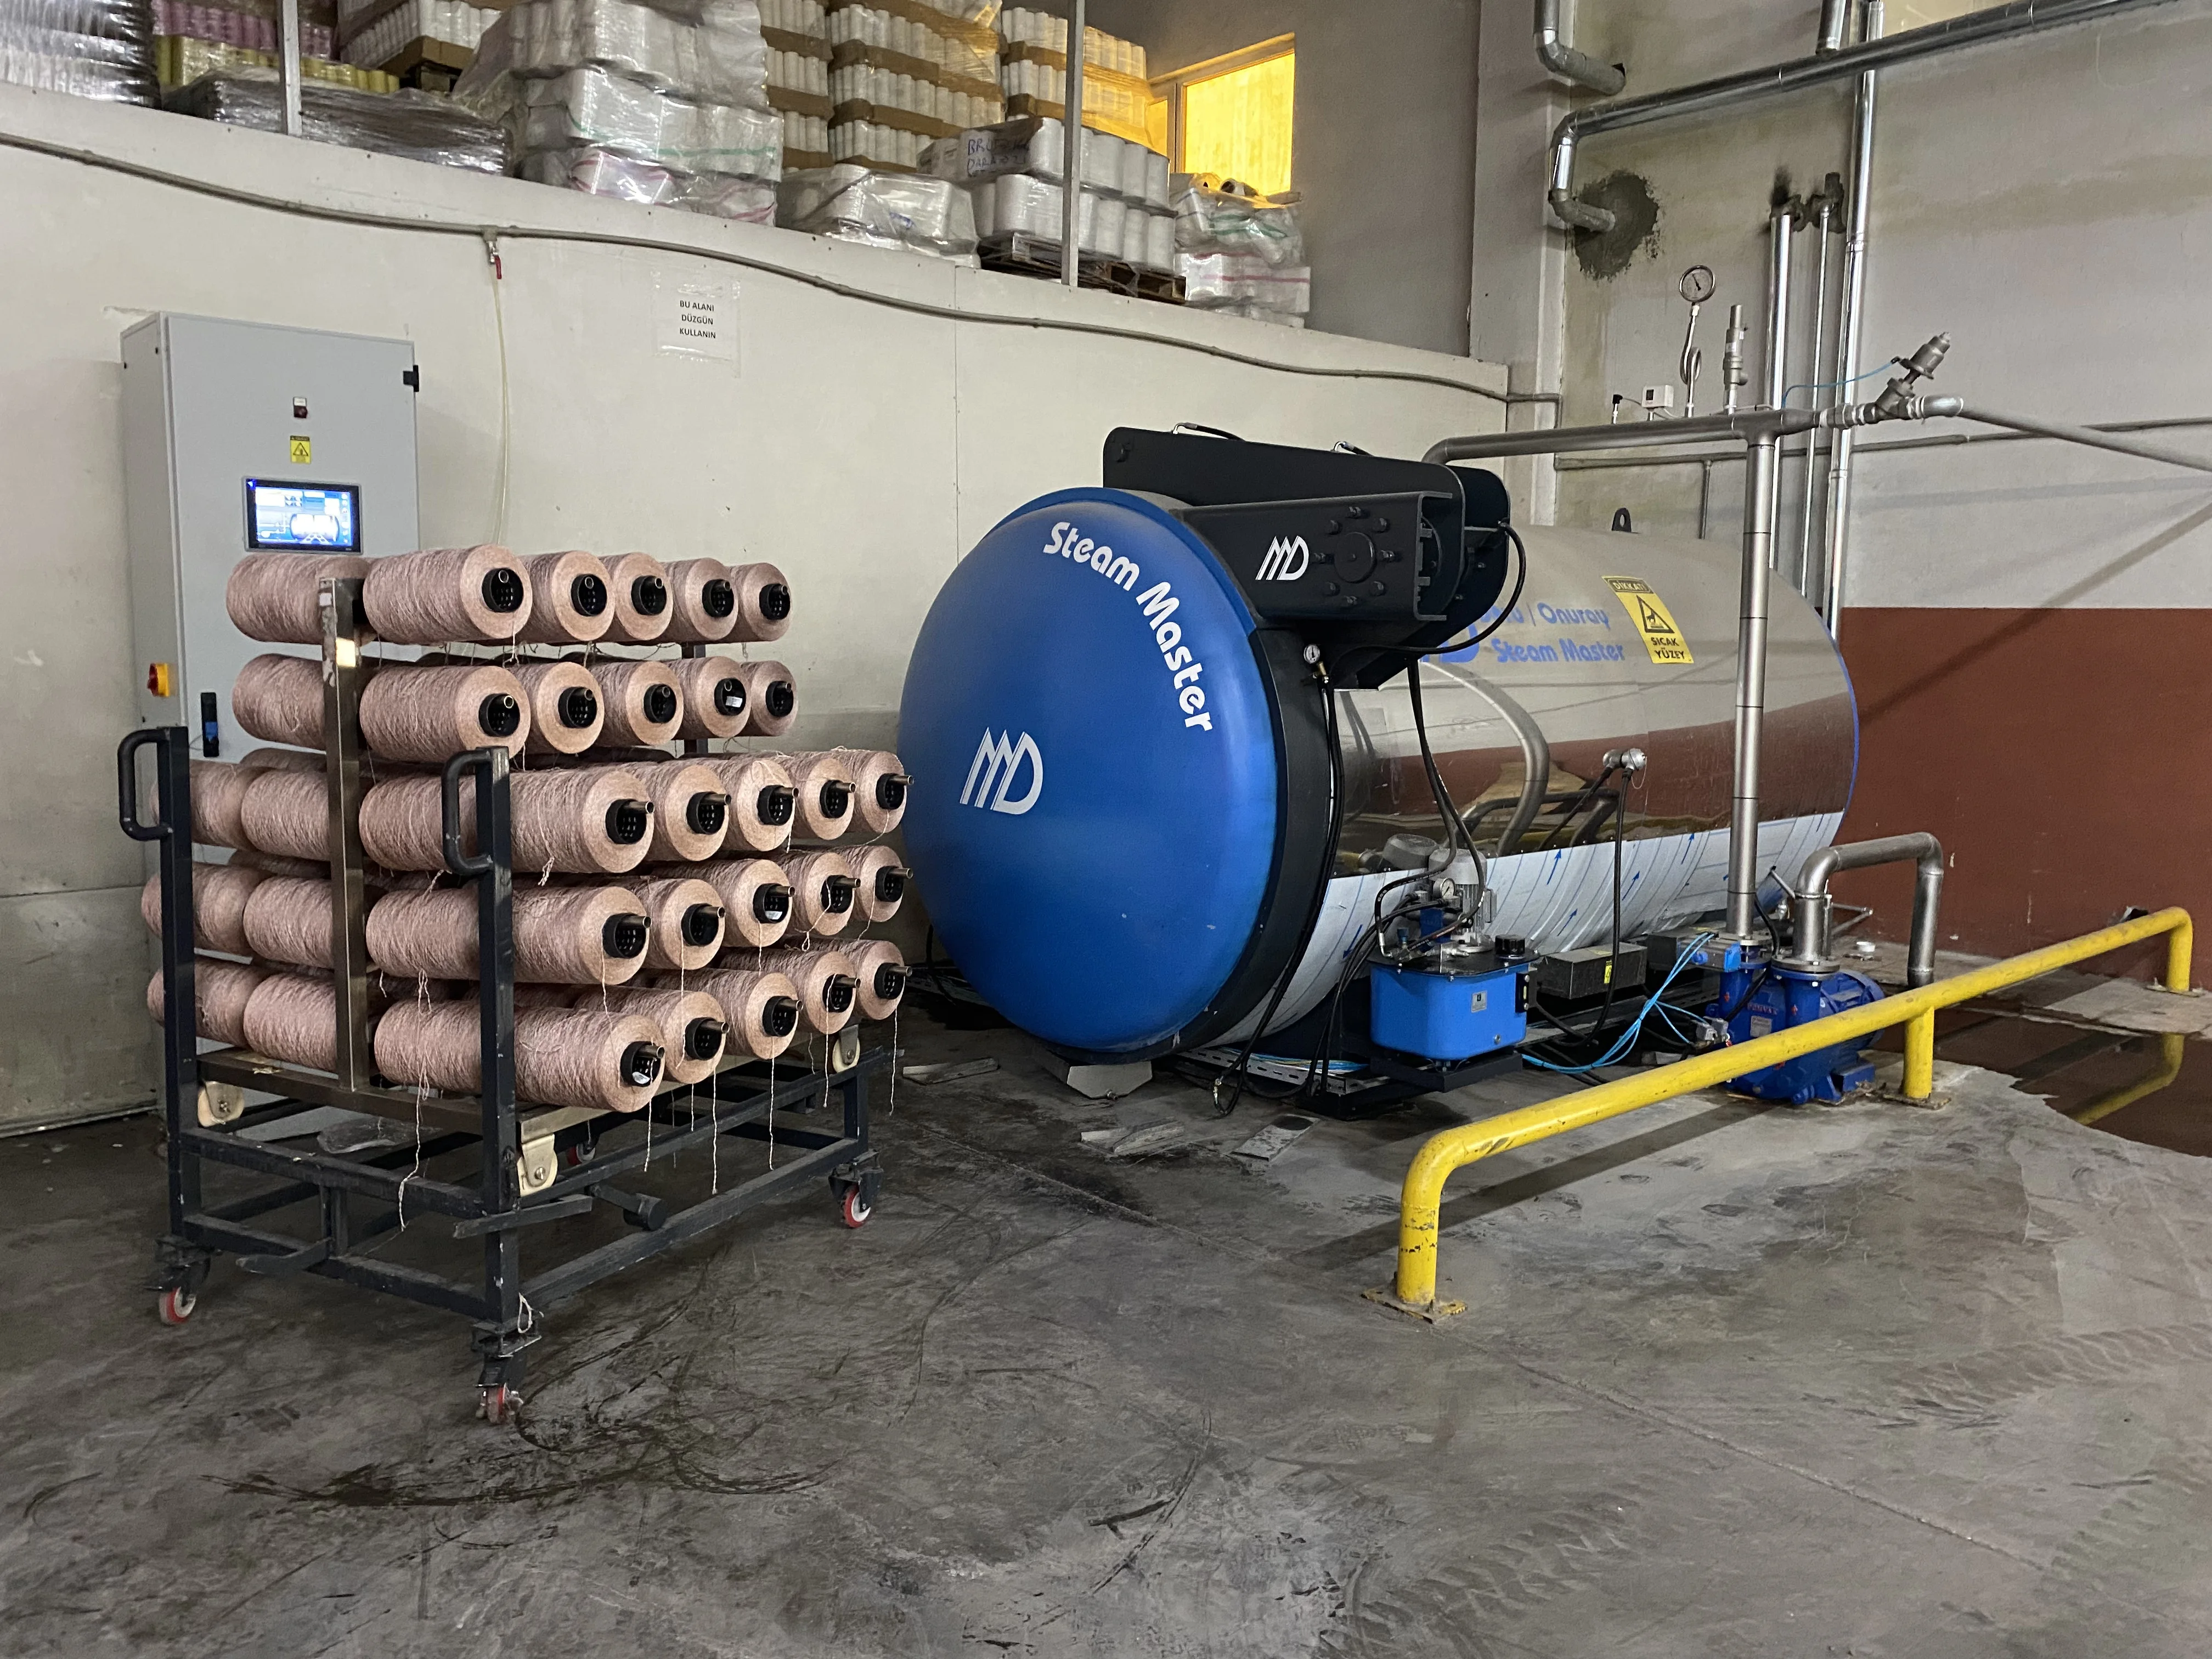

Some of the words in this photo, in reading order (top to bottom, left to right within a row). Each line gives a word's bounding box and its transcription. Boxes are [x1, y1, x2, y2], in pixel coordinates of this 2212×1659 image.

[680, 300, 690, 308] BU
[692, 302, 714, 312] ALANI
[681, 313, 713, 325] DÜZGÜN
[679, 328, 716, 338] KULLANIN
[1537, 602, 1611, 631] Onuray
[1043, 521, 1140, 591] Steam
[1136, 582, 1213, 731] Master
[1650, 636, 1680, 646] SICAK
[1491, 637, 1559, 663] Steam
[1559, 638, 1626, 662] Master
[1654, 647, 1685, 659] YÜZEY
